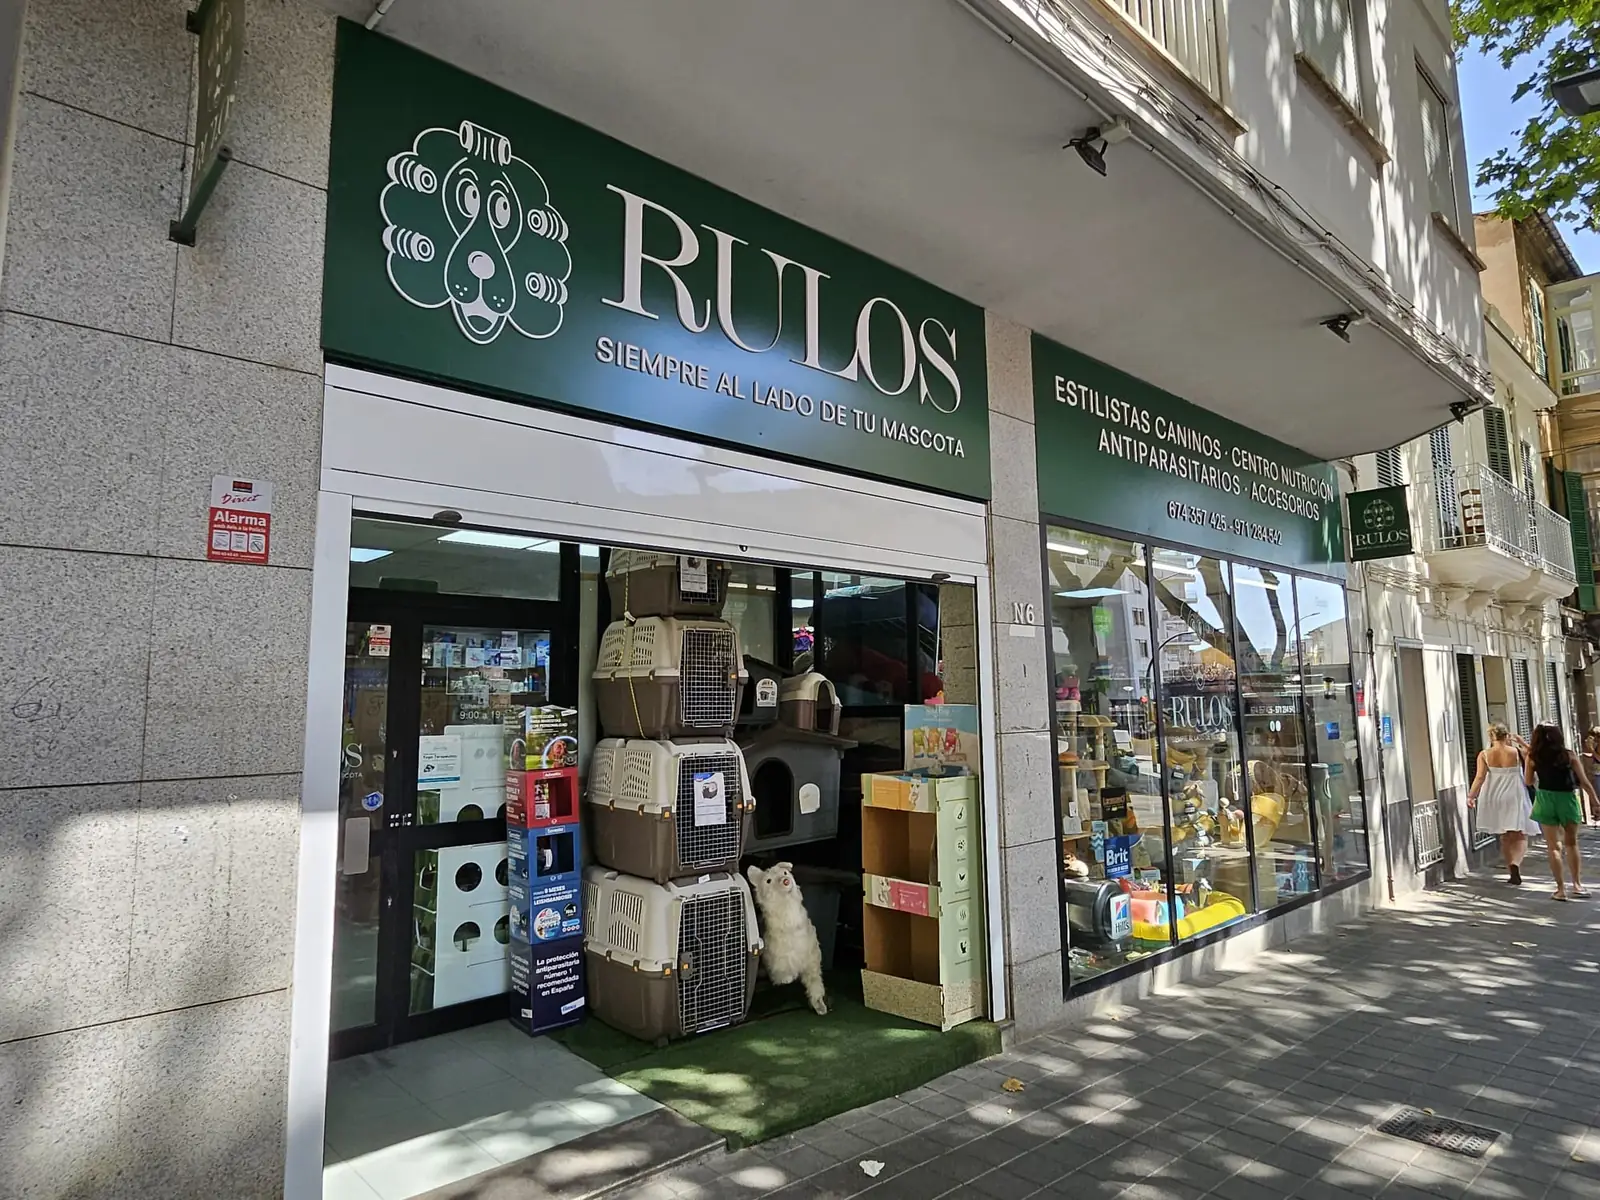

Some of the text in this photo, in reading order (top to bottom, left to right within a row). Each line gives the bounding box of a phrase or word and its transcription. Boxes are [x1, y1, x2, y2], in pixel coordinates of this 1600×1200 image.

[602, 184, 961, 413] RULOS
[596, 336, 965, 458] SIEMPRE AL LADO DE TU MASCOTA
[1055, 375, 1151, 434] ESTILISTAS
[1155, 416, 1221, 460] CANINOS
[1231, 446, 1279, 481] CENTRO
[1281, 465, 1334, 503] NUTRICIÓN
[1098, 428, 1241, 495] ANTIPARASITARIOS
[1250, 480, 1320, 521] ACCESORIOS
[214, 511, 267, 527] Alarma
[1167, 501, 1188, 521] 674
[1189, 506, 1207, 526] 357
[1209, 512, 1227, 532] 425
[1233, 519, 1250, 537] 971
[1355, 529, 1409, 547] RULOS
[460, 711, 479, 720] 9:00
[1170, 695, 1233, 730] RULOS
[1106, 848, 1128, 866] Brit
[536, 959, 580, 974] antiparasitaria
[546, 951, 579, 964] protección
[537, 974, 580, 989] recomendada
[543, 970, 568, 980] número
